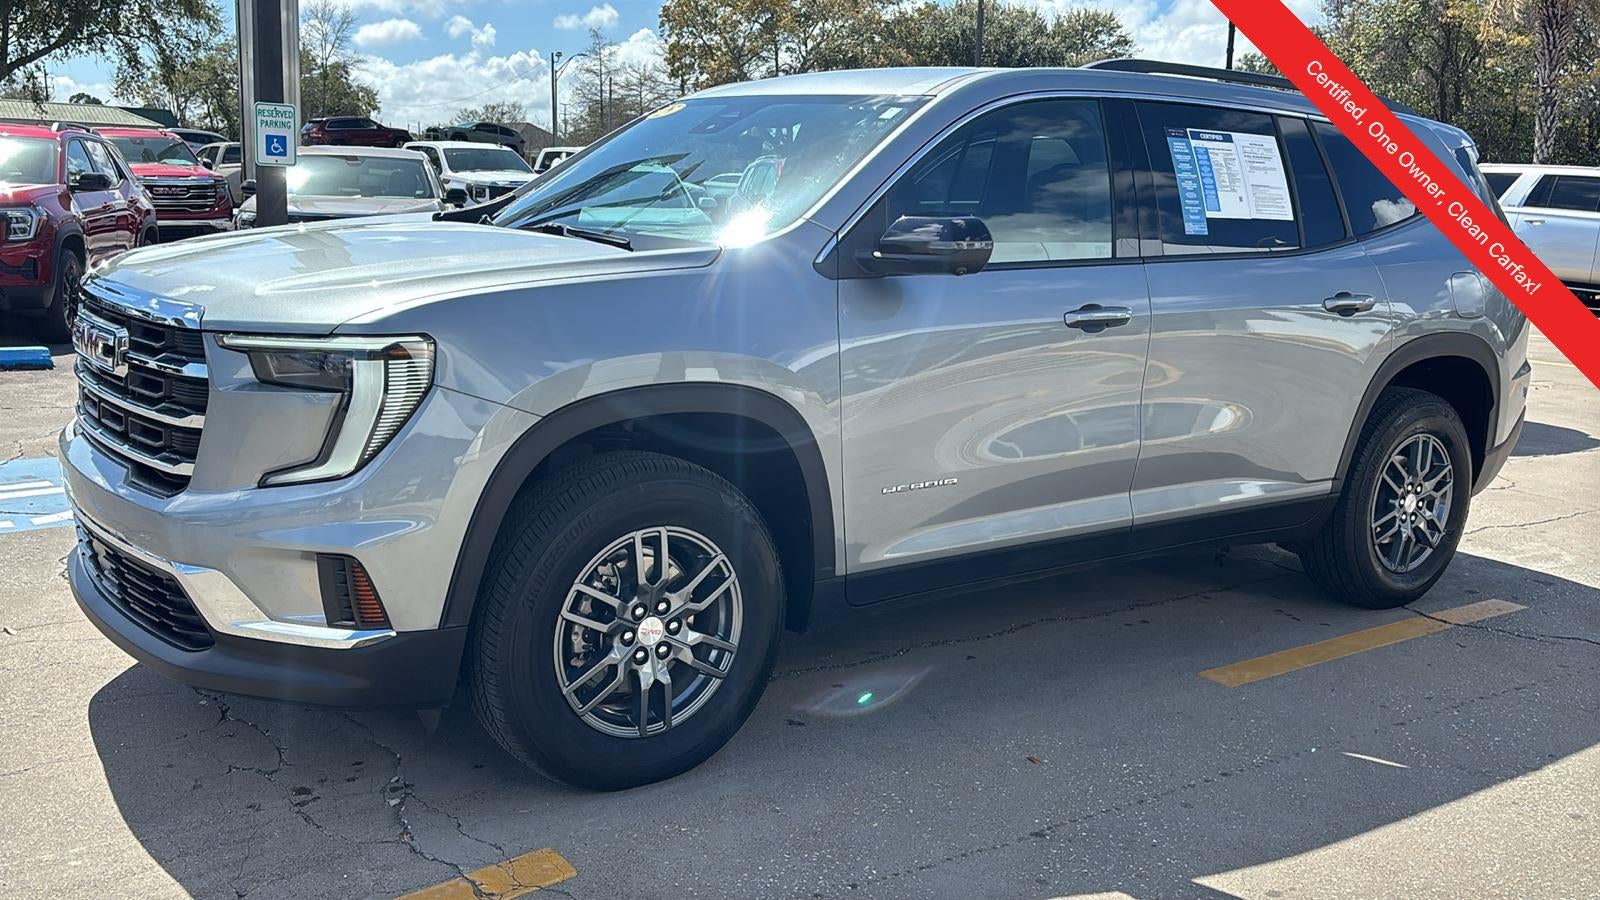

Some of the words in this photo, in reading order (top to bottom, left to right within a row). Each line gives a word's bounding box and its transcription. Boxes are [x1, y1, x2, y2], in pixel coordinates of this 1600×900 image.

[257, 109, 294, 119] RESERVED
[260, 120, 292, 129] PARKING
[152, 187, 188, 195] GMC
[72, 319, 116, 370] GMC
[881, 477, 959, 495] ACADIA
[521, 512, 595, 612] BRIDGESTONE
